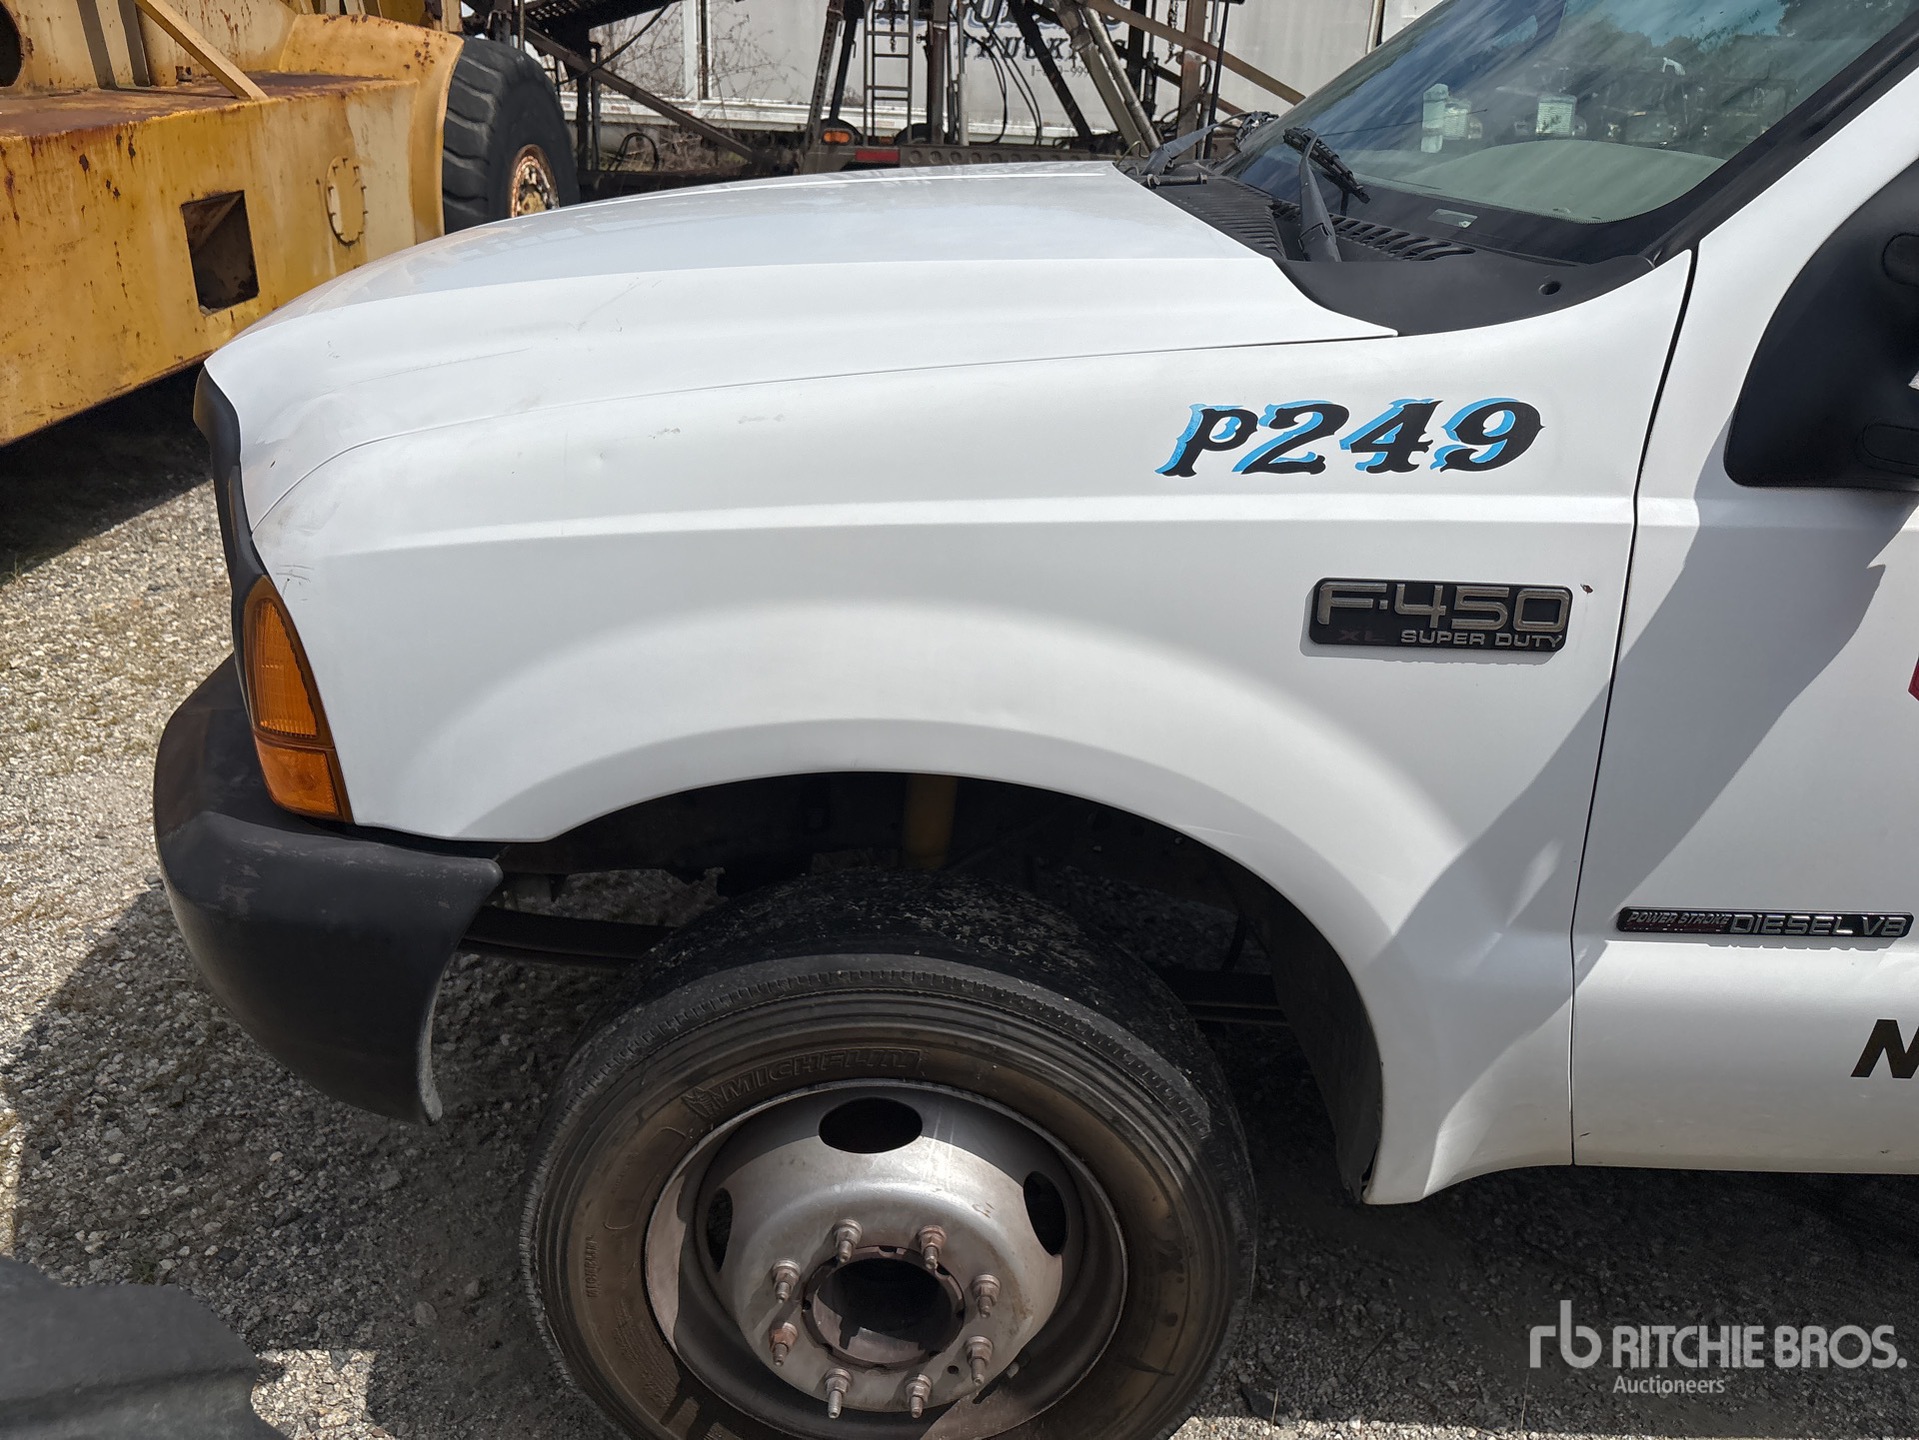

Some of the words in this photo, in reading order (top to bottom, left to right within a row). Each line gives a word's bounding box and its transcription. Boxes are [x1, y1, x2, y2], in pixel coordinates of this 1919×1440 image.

[1155, 397, 1545, 477] P249
[1401, 629, 1486, 646] SUPER
[1495, 632, 1563, 649] DUTY
[1627, 911, 1678, 924] POWER
[1679, 913, 1733, 925] STROKE
[1730, 914, 1853, 935] DIESEL
[1862, 916, 1906, 936] V8
